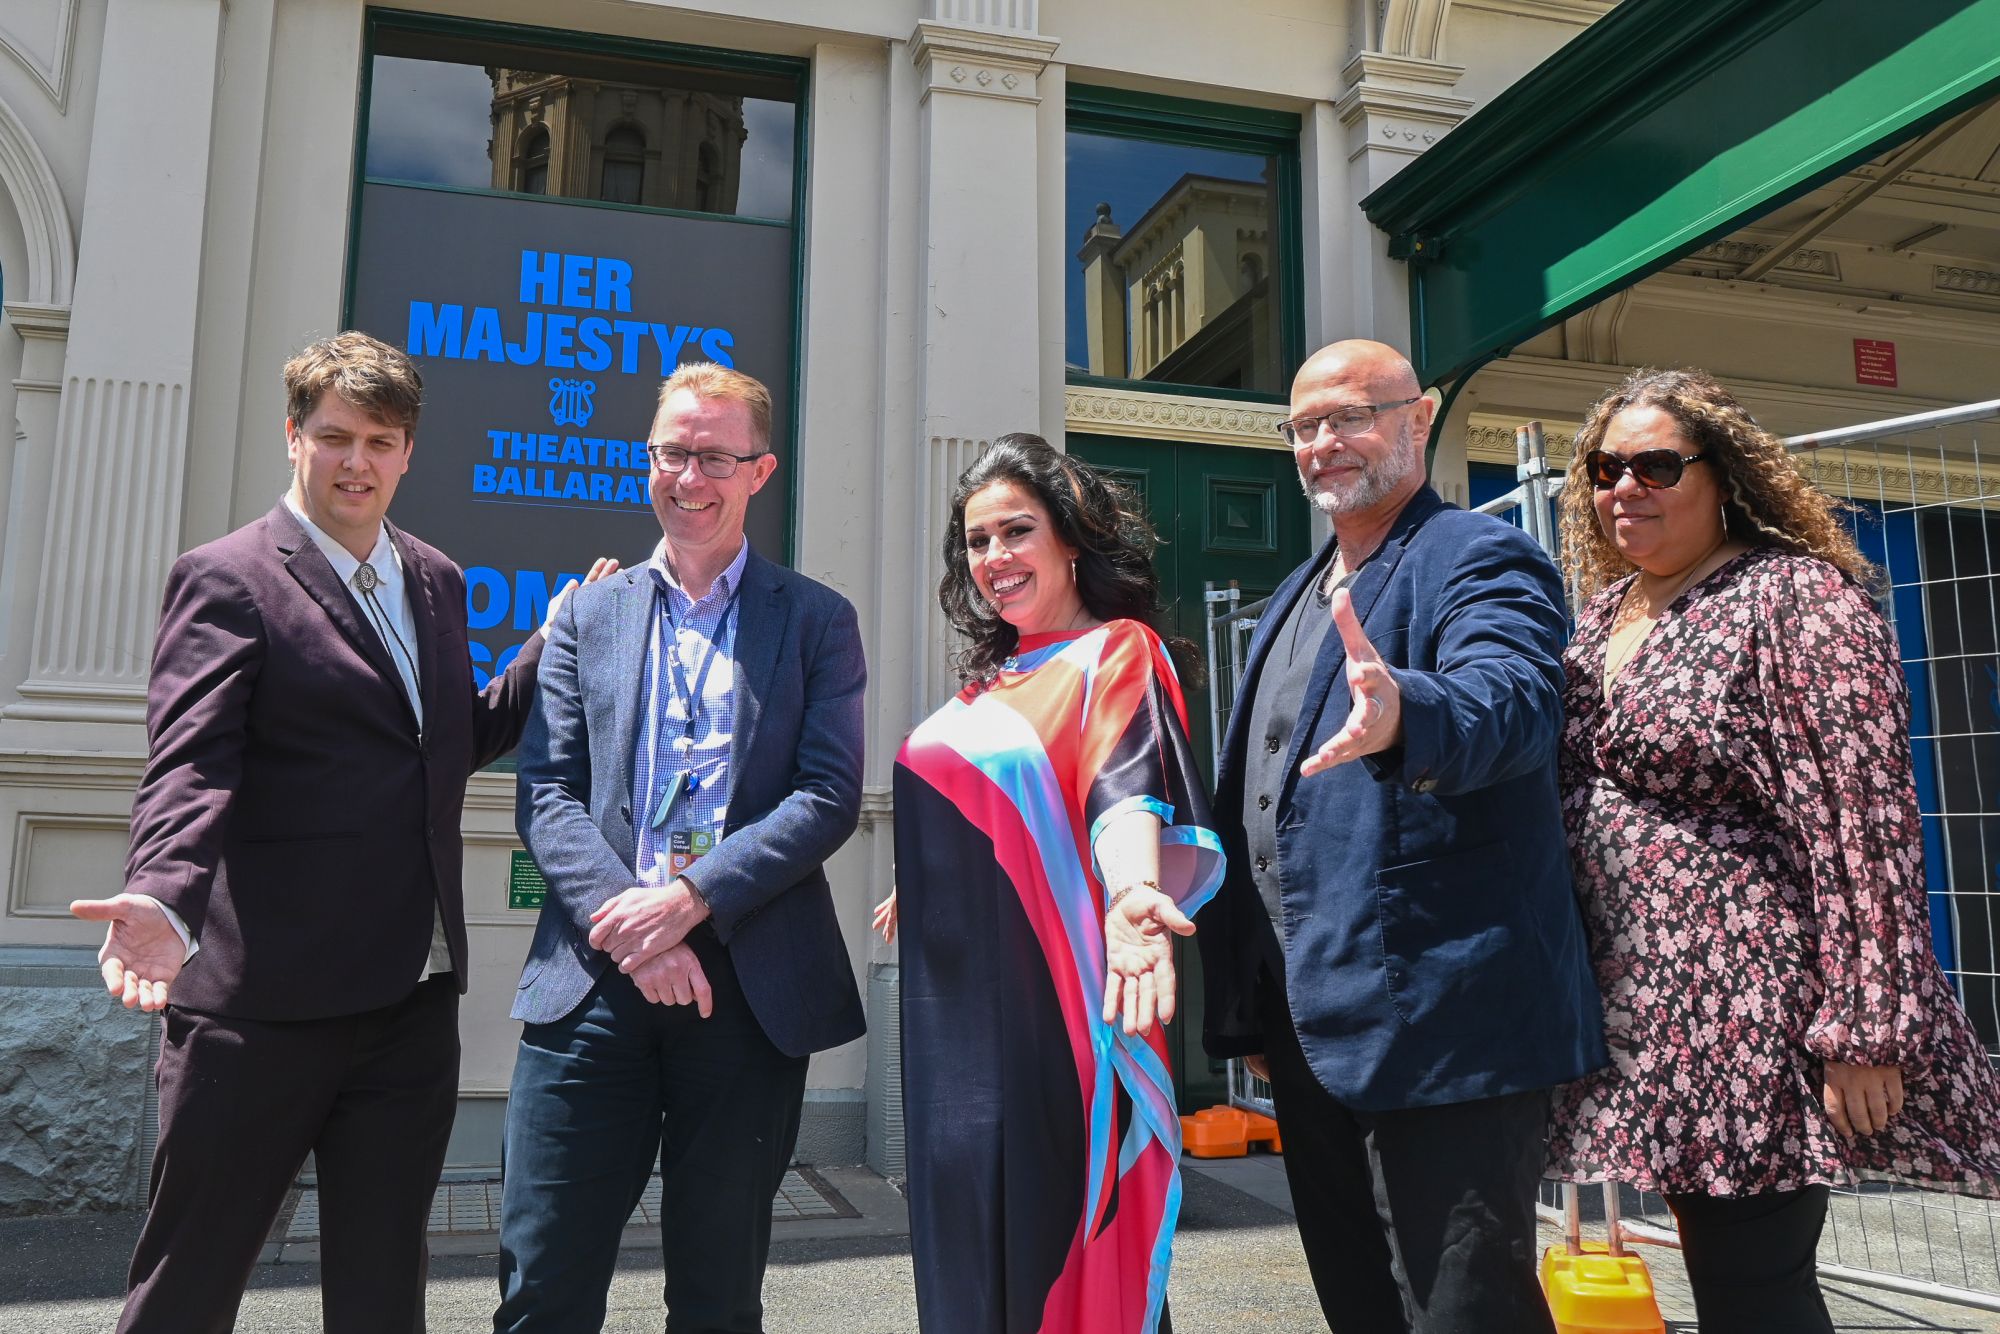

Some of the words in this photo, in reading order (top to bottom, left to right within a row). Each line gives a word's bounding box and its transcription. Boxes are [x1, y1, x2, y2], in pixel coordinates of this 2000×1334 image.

[519, 250, 633, 313] HER
[407, 300, 735, 376] MAJESTY'S
[487, 430, 650, 470] THEATRE
[473, 464, 653, 505] BALLARAT
